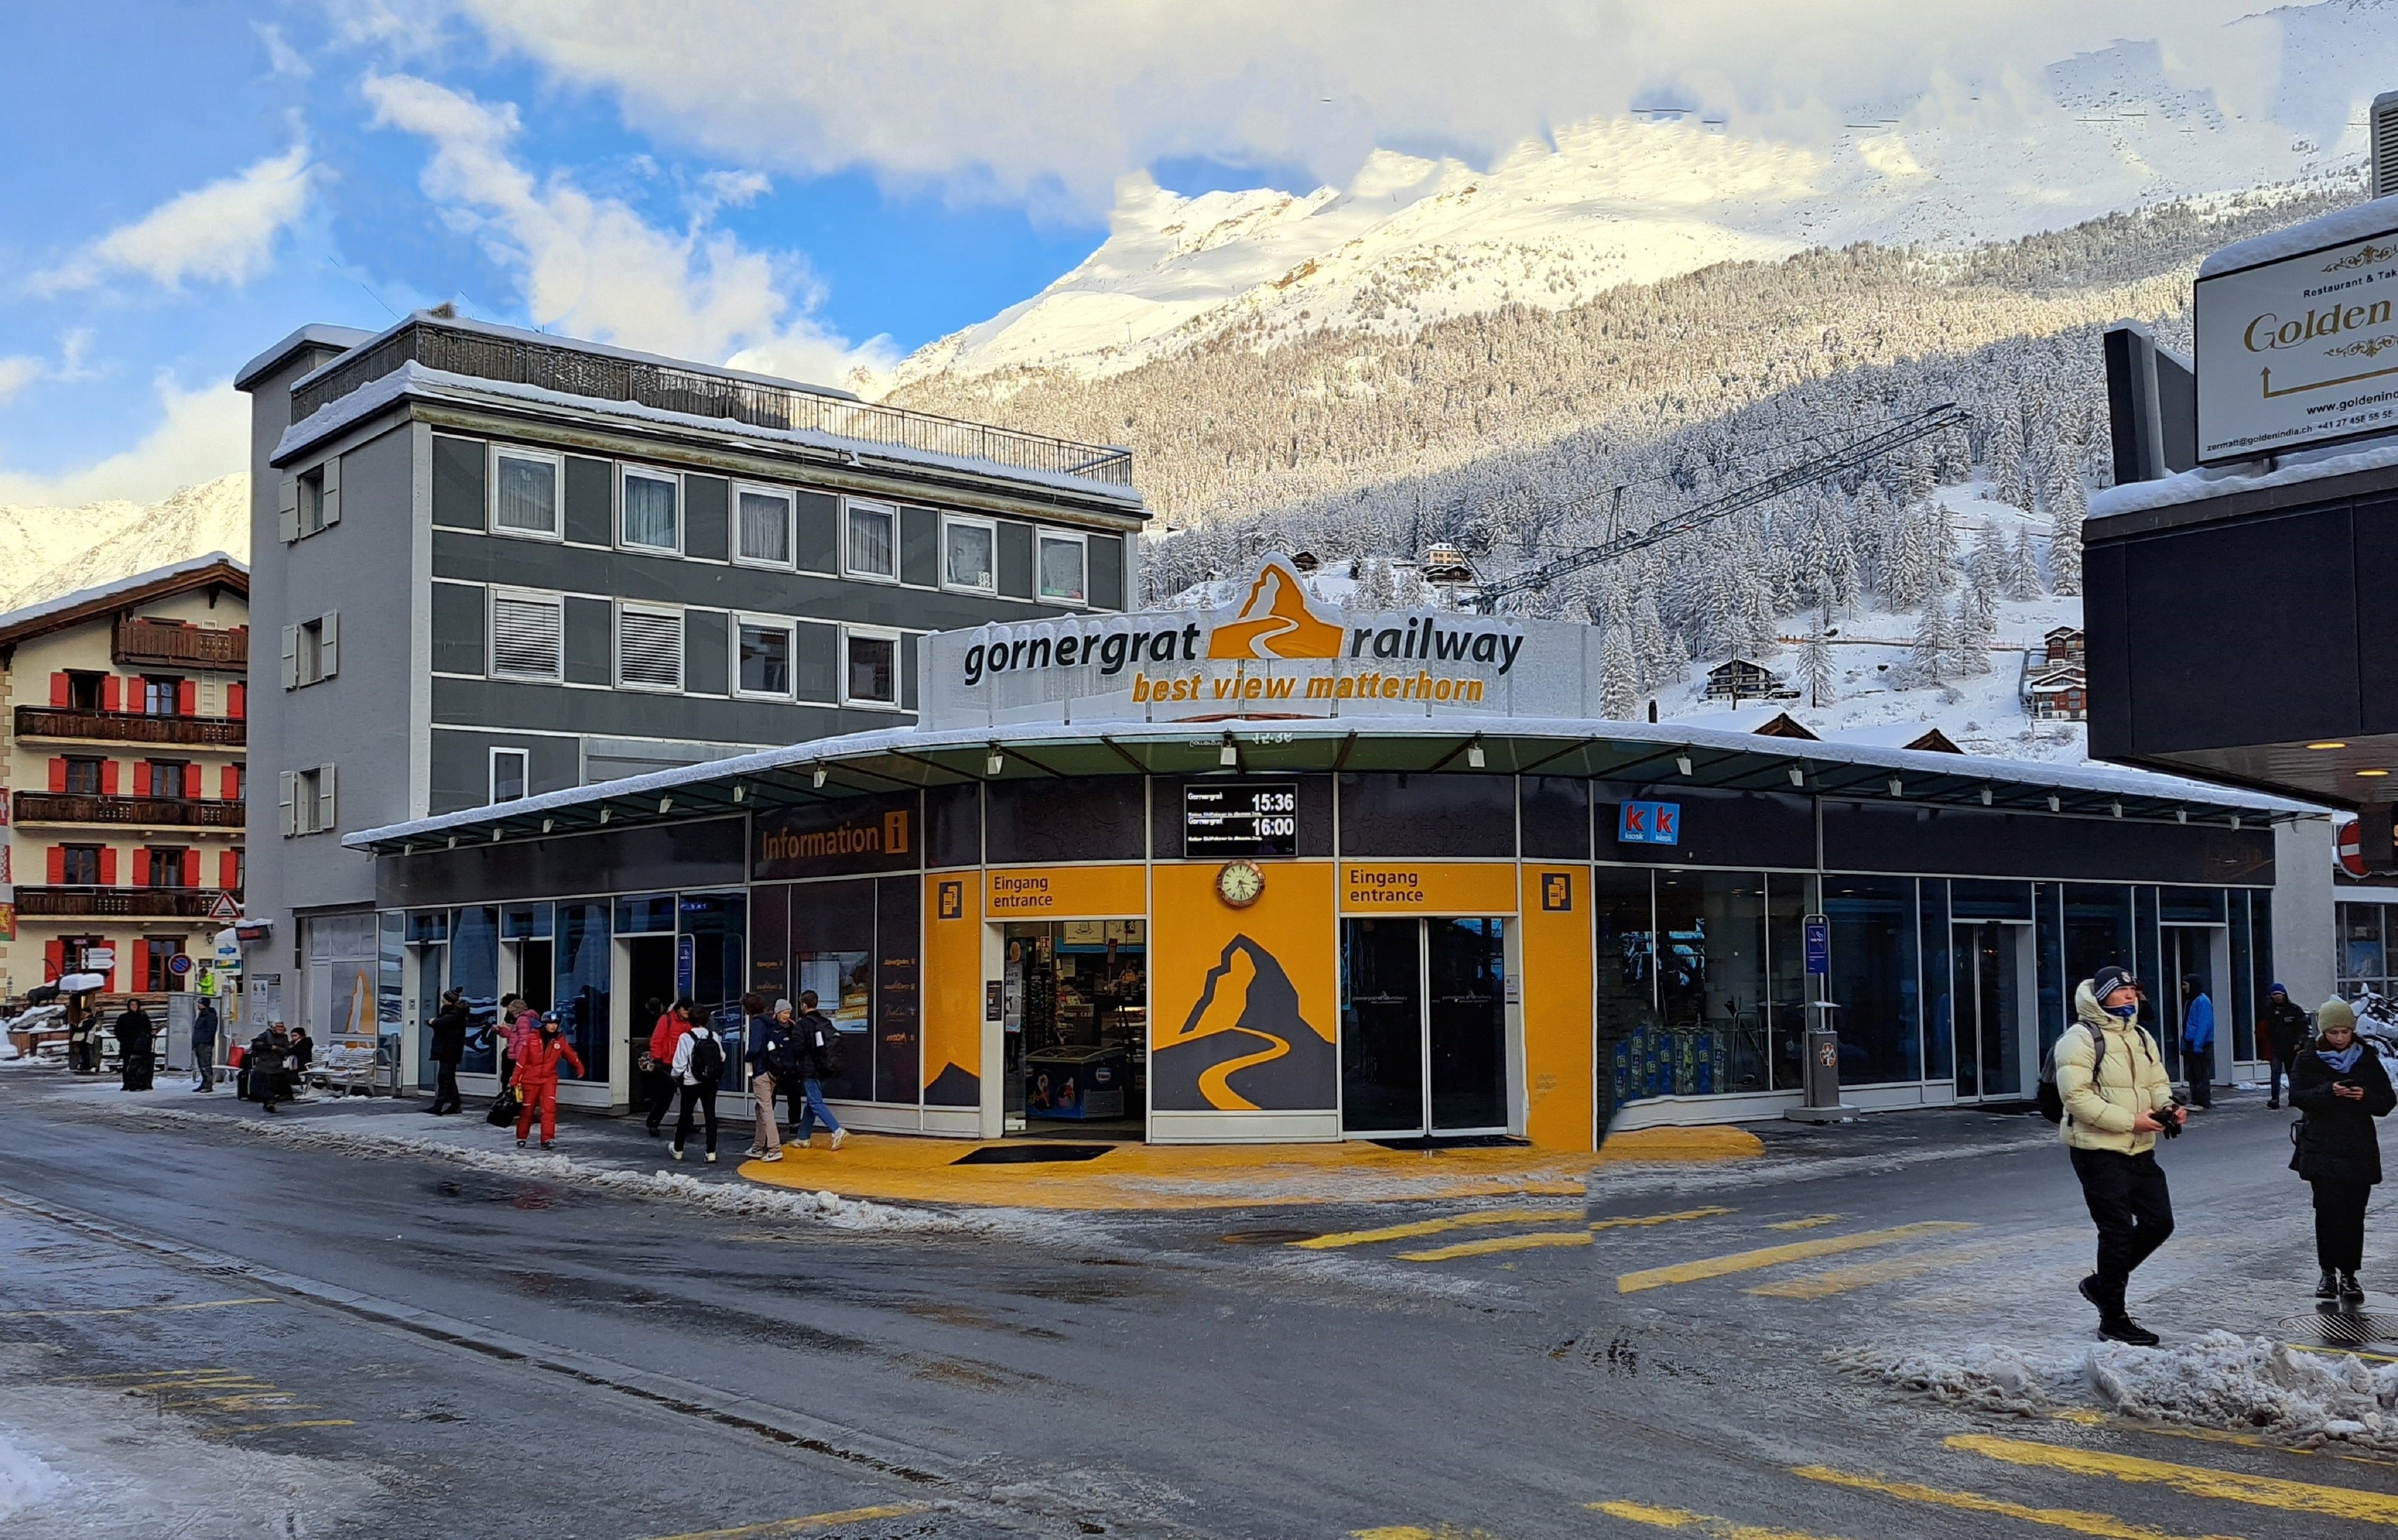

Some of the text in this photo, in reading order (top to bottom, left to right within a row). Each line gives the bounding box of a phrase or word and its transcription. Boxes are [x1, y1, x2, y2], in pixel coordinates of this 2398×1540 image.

[2304, 278, 2363, 298] Restaurant
[2367, 274, 2373, 283] &
[2244, 300, 2392, 352] Golden
[2207, 425, 2312, 451] zermatt@goldenindia.ch
[2336, 418, 2347, 426] 27
[965, 623, 1200, 686] gornergrat
[1351, 617, 1524, 676] railway
[1132, 669, 1484, 703] best view matterhorn
[1252, 793, 1294, 812] 15:36
[1252, 818, 1294, 836] 16:00
[1626, 804, 1645, 832] k
[1656, 806, 1674, 833] k
[763, 821, 879, 860] Information
[1625, 832, 1644, 840] kiosk
[994, 876, 1048, 893] Eingang
[1350, 869, 1418, 888] Eingang
[994, 894, 1053, 908] entrance
[1350, 889, 1423, 902] entrance
